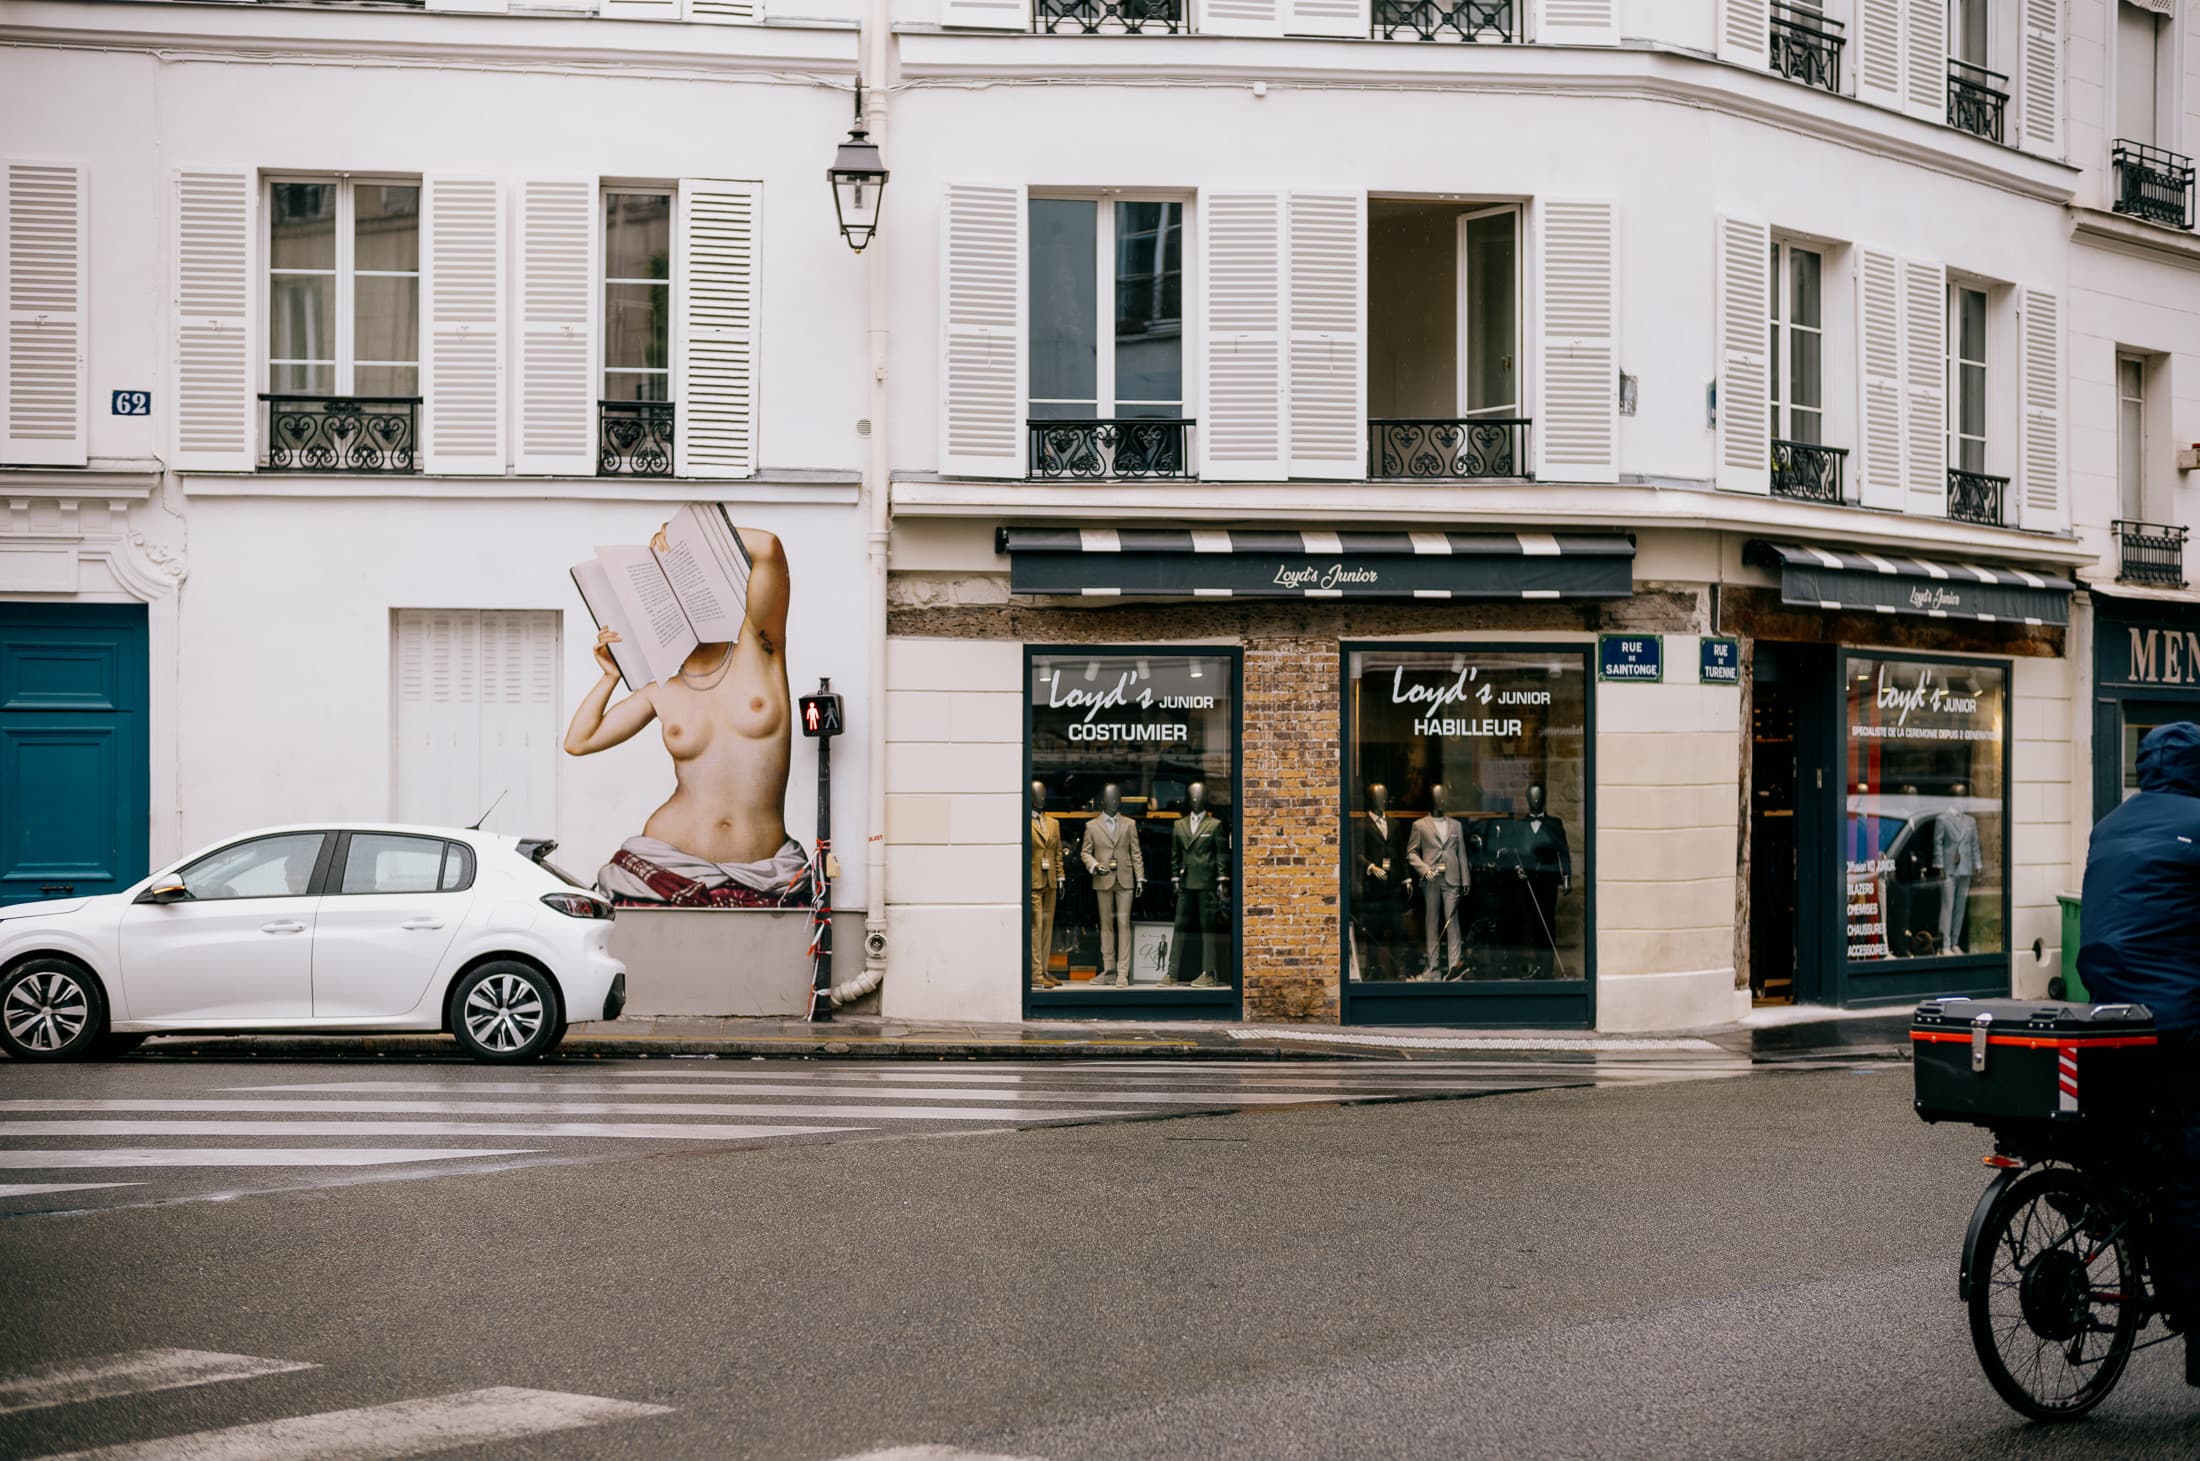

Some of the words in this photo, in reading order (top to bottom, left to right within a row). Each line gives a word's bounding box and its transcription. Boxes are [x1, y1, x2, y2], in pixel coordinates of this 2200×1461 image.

[116, 392, 146, 414] 62
[1273, 564, 1319, 588] Loyd's
[1320, 564, 1378, 589] Junior
[1622, 642, 1642, 653] RUE
[1713, 644, 1728, 656] RUE
[1605, 664, 1657, 676] SAINTONGE
[1704, 665, 1736, 678] TURENNE
[1049, 669, 1154, 723] Loyd's
[1159, 695, 1214, 709] JUNIOR
[1392, 665, 1493, 718] Loyd's
[1497, 691, 1551, 705] JUNIOR
[1877, 664, 1941, 726] Loyd's
[1943, 698, 1977, 713] JUNIOR
[1068, 723, 1188, 741] COSTUMIER
[1414, 718, 1522, 736] HABILLEUR
[1887, 727, 1896, 738] DE
[1896, 727, 1905, 738] LA
[1847, 882, 1874, 895] BLAZERS
[1847, 903, 1878, 916] CHEMISES
